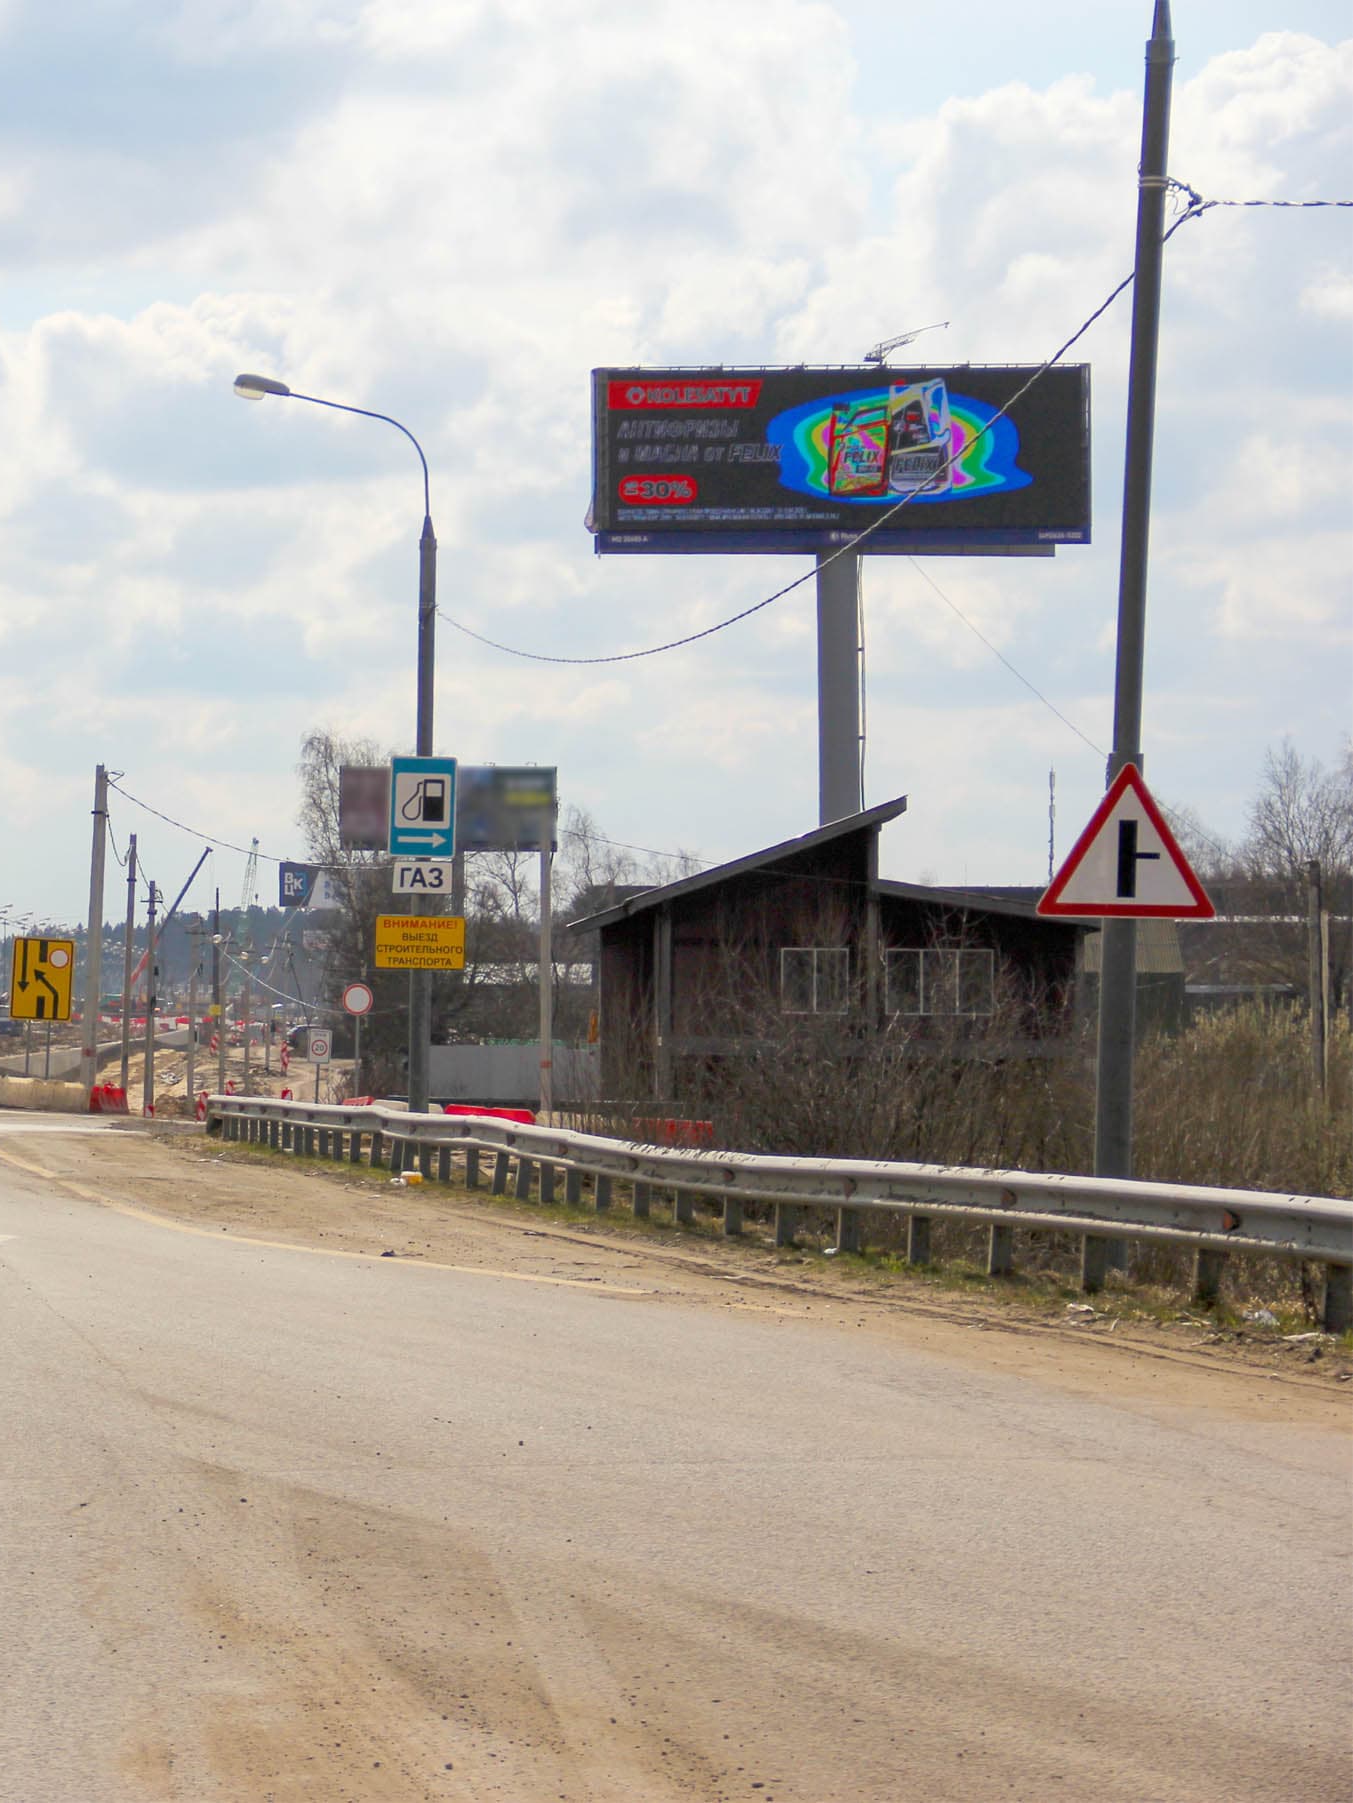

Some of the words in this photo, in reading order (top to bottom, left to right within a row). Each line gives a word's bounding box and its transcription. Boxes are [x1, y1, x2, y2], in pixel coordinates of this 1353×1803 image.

[399, 867, 444, 888] ГАЗ
[383, 919, 457, 930] ВНИМАНИЕ!
[402, 932, 439, 942] ВЫЕЗД
[376, 944, 464, 955] СТРОИТЕЛЬНОГО
[386, 956, 453, 967] ТРАНСПОРТА
[315, 1043, 325, 1052] 20
